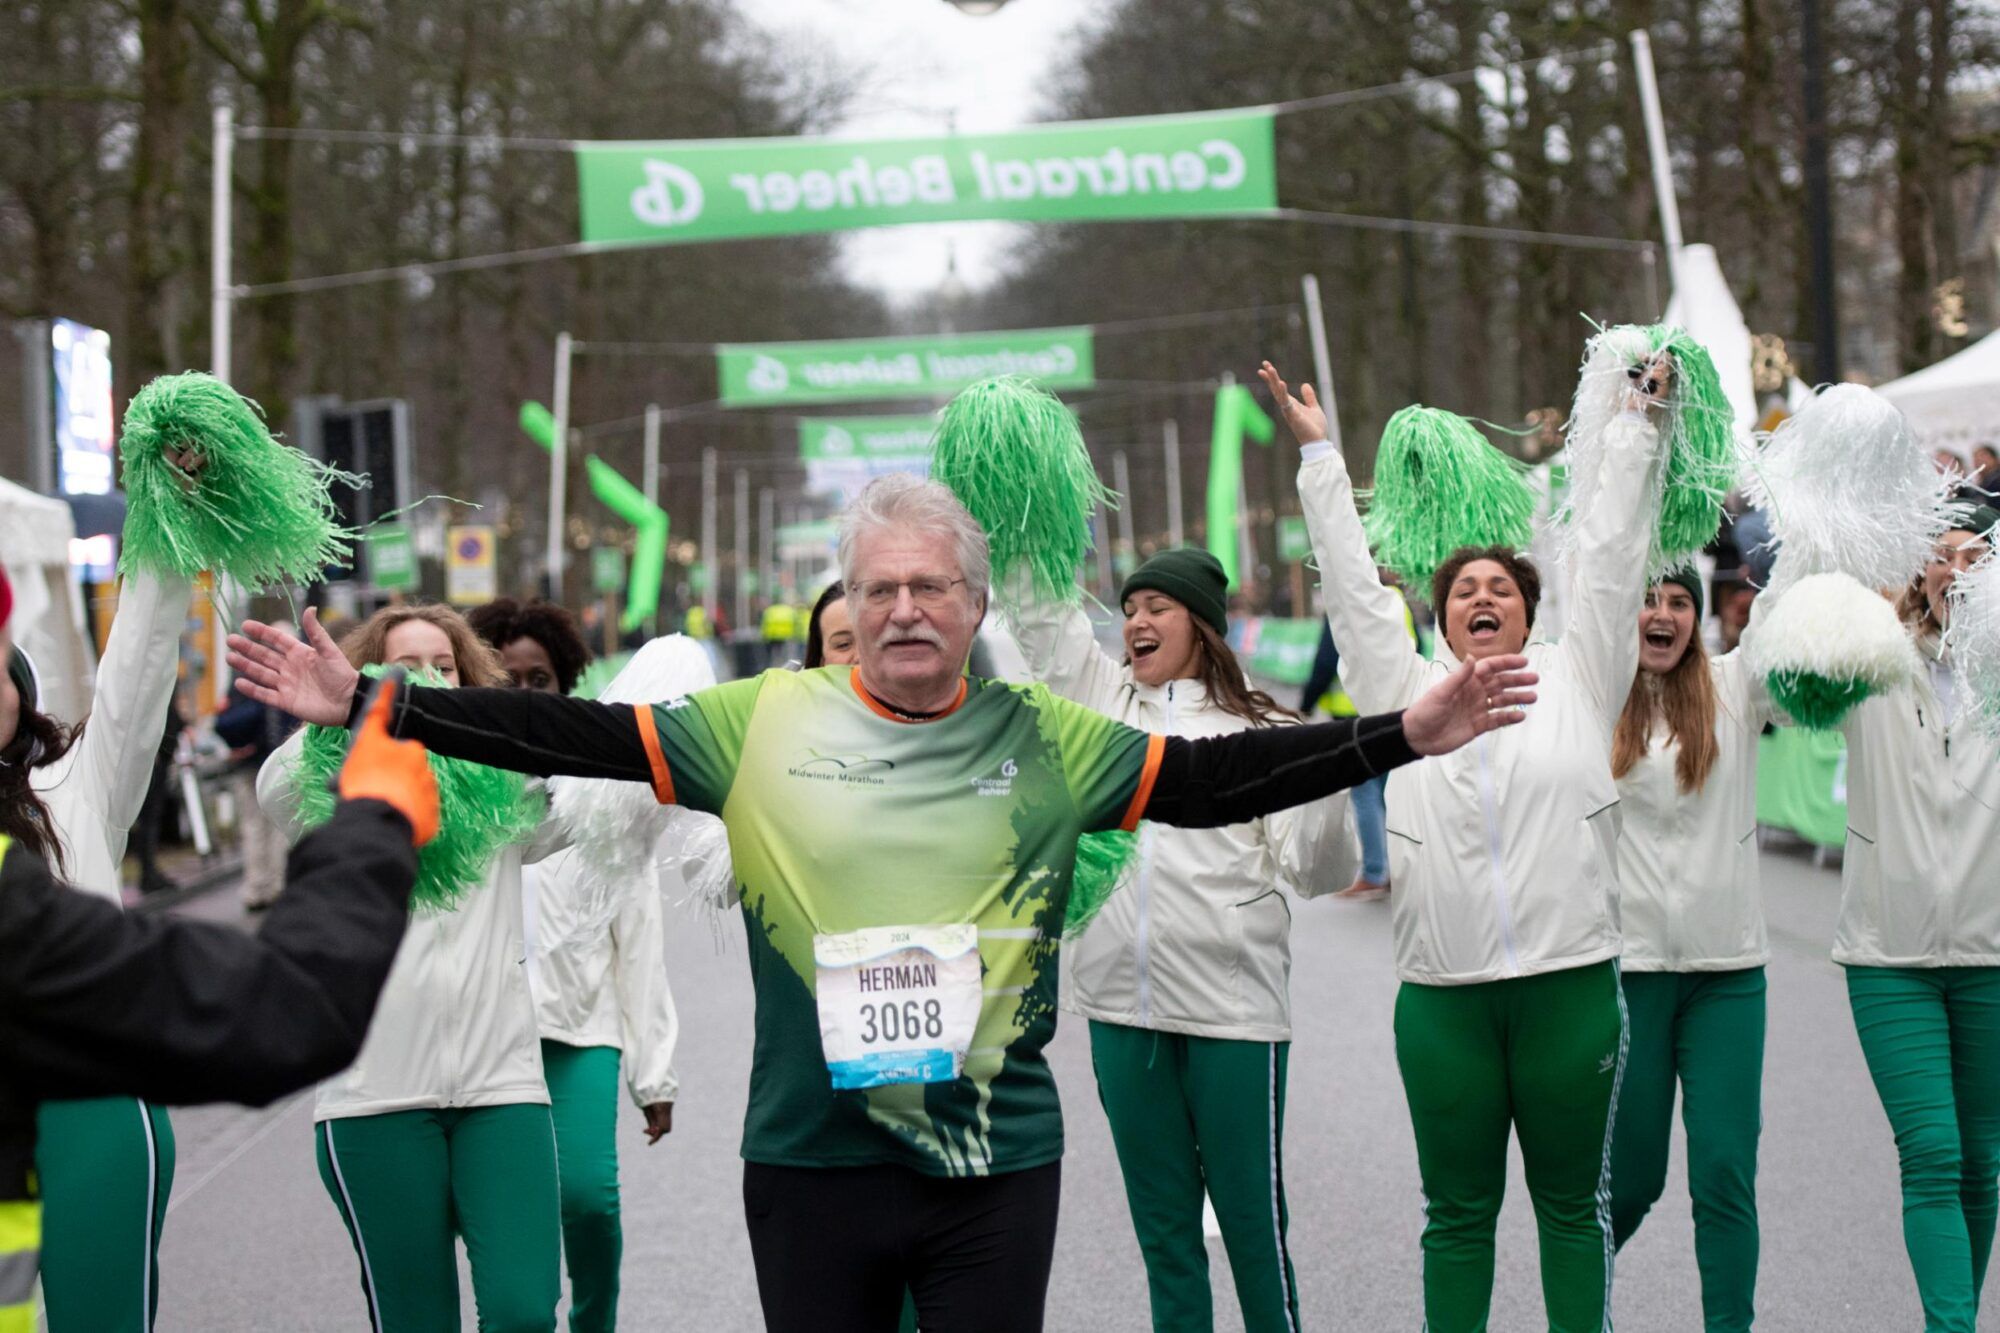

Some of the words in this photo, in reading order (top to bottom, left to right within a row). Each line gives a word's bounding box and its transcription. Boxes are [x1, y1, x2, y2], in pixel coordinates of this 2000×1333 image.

[787, 767, 835, 781] Midwinter
[838, 772, 885, 786] Marathon
[890, 933, 912, 944] 2024
[858, 963, 938, 993] HERMAN
[859, 998, 944, 1045] 3068
